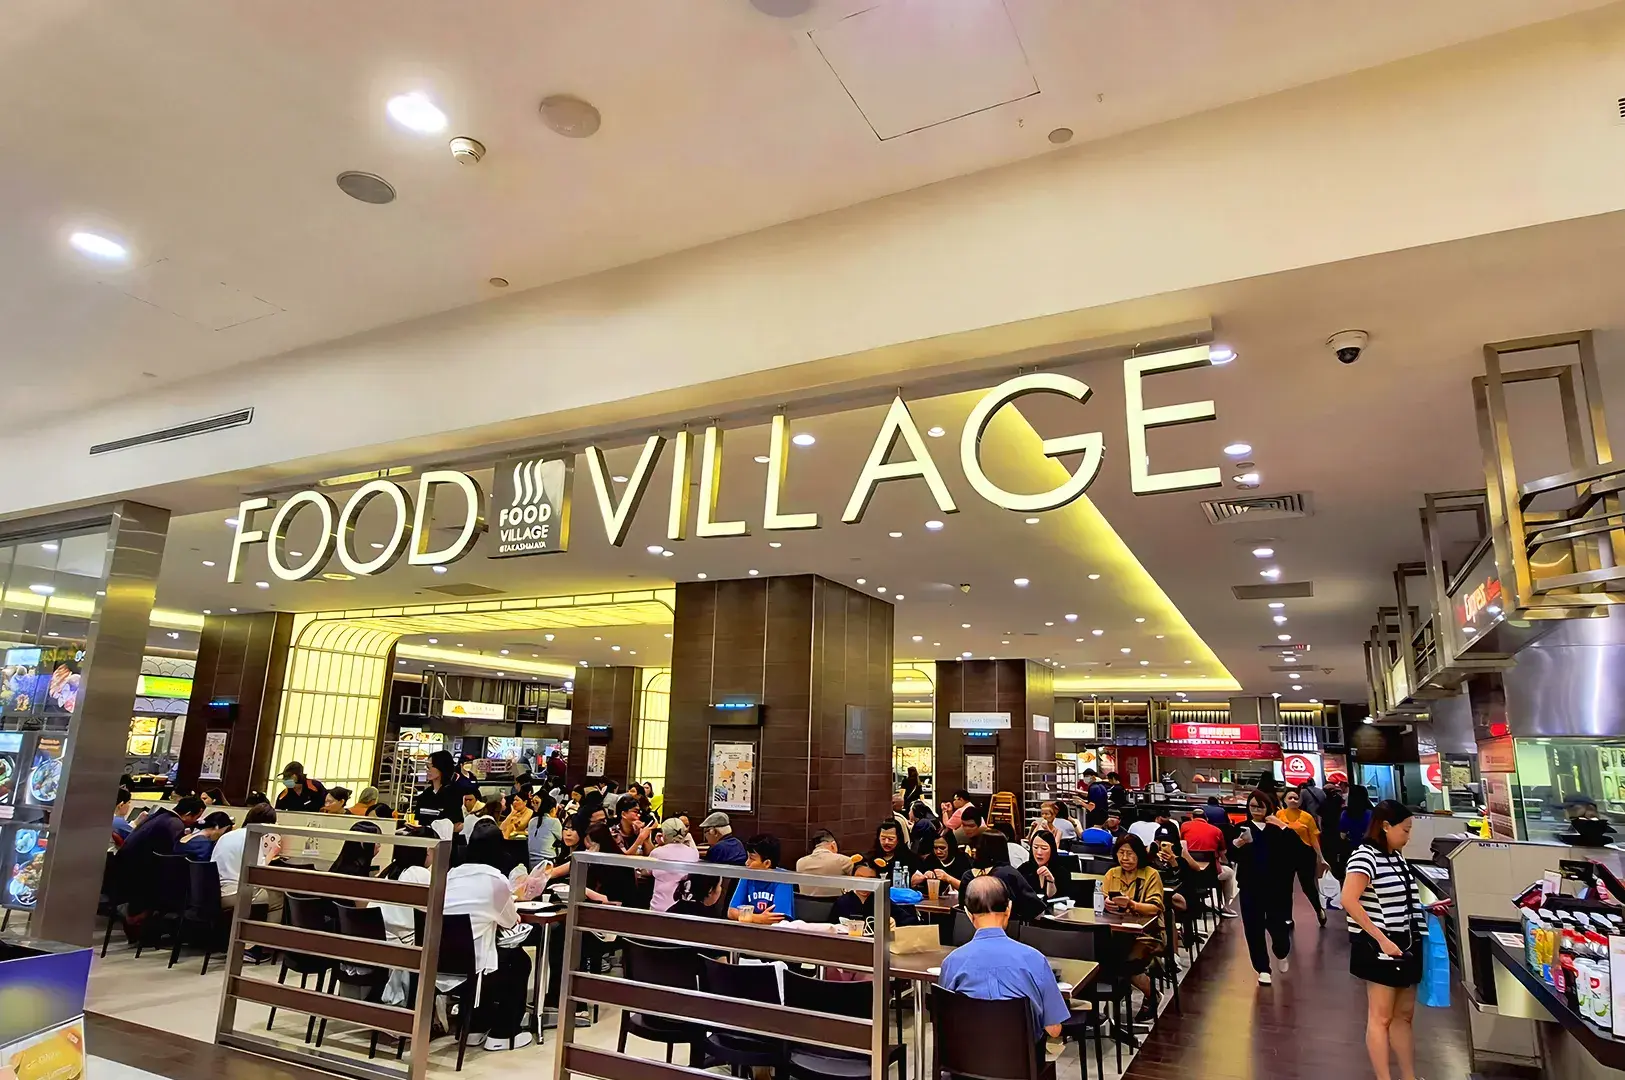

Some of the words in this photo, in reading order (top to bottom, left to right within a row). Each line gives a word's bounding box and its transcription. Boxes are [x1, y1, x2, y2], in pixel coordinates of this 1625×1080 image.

[228, 470, 482, 582] FOOD
[585, 345, 1222, 547] VILLAGE
[499, 503, 552, 527] FOOD
[500, 524, 550, 542] VILLAGE
